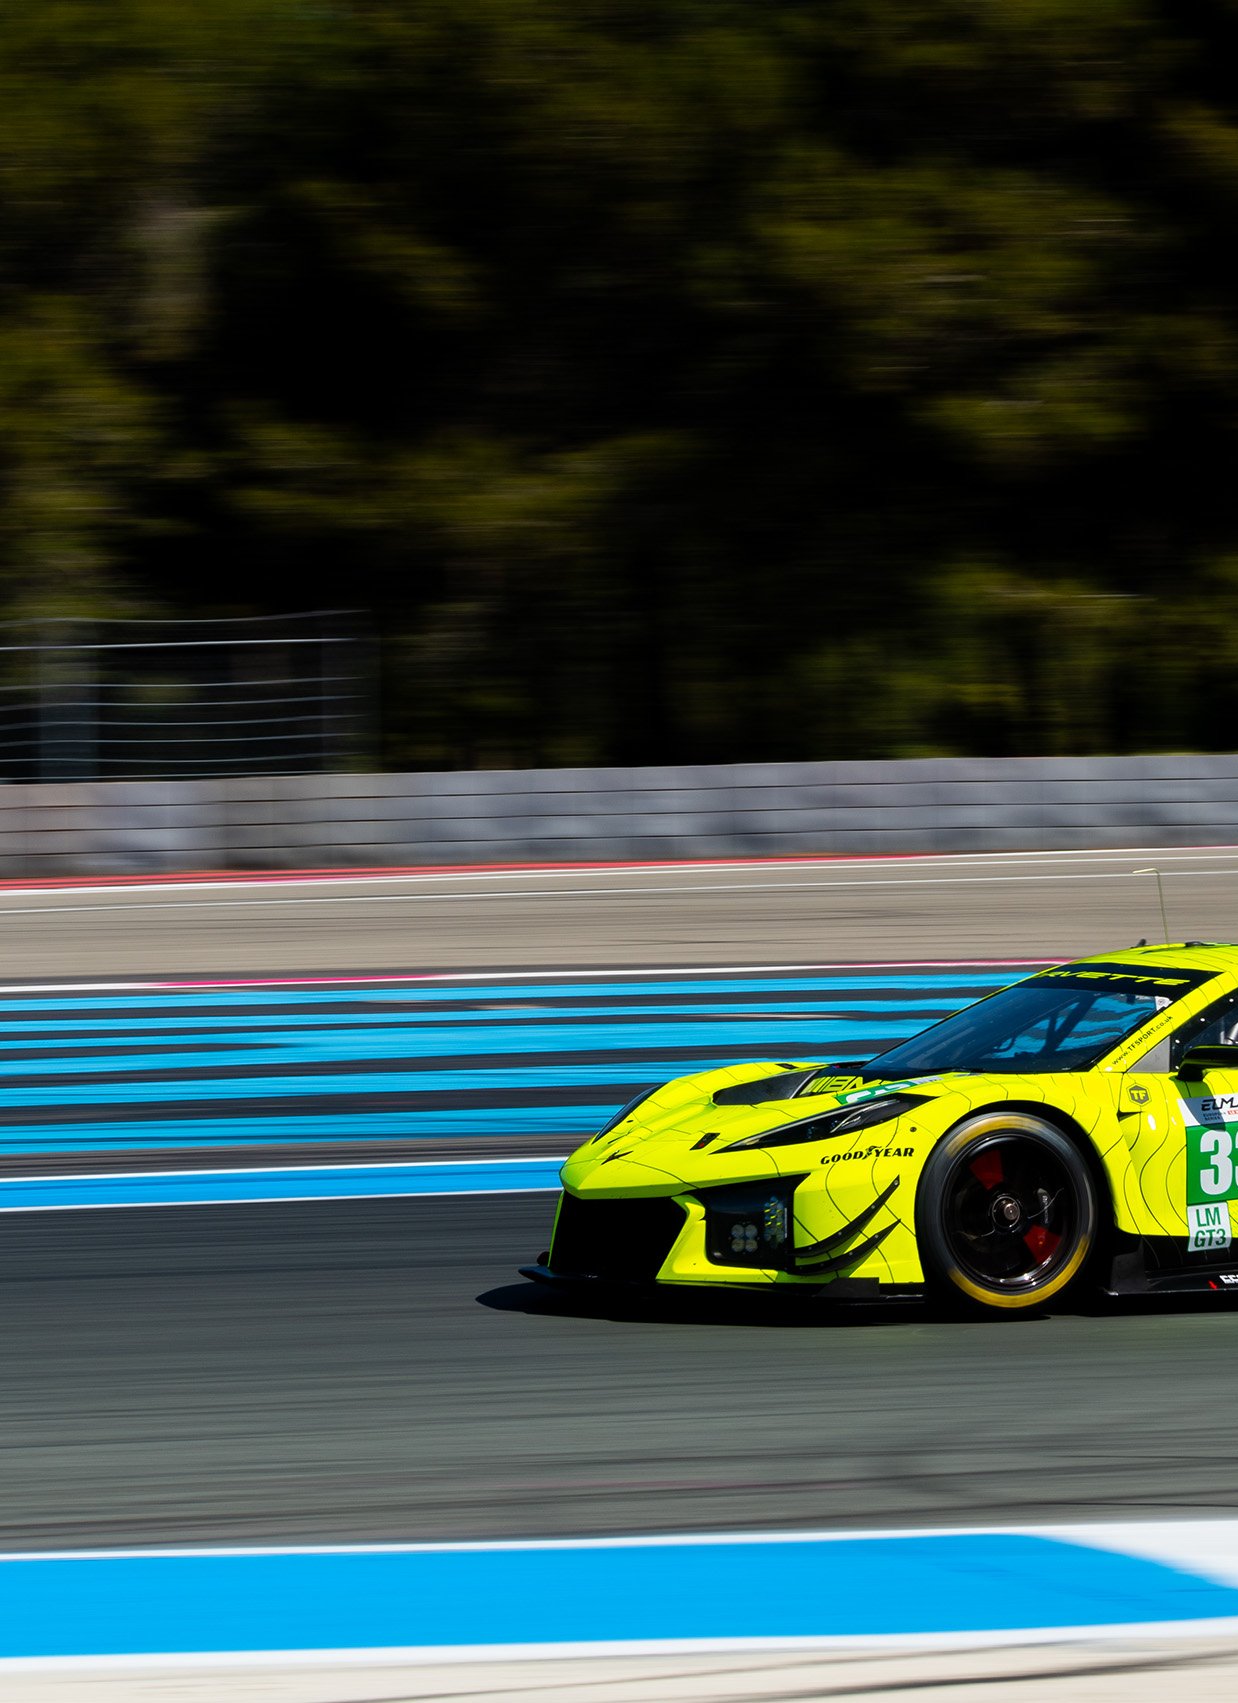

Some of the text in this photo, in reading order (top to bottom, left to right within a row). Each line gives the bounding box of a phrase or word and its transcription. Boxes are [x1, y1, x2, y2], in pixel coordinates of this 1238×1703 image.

[1040, 970, 1191, 986] RVETTE
[1111, 1015, 1173, 1066] www.TFSPORT.co.uk
[1130, 1089, 1146, 1101] TF
[820, 1145, 915, 1165] GOODYEAR
[1195, 1206, 1222, 1228] LM
[1194, 1227, 1227, 1248] GT3
